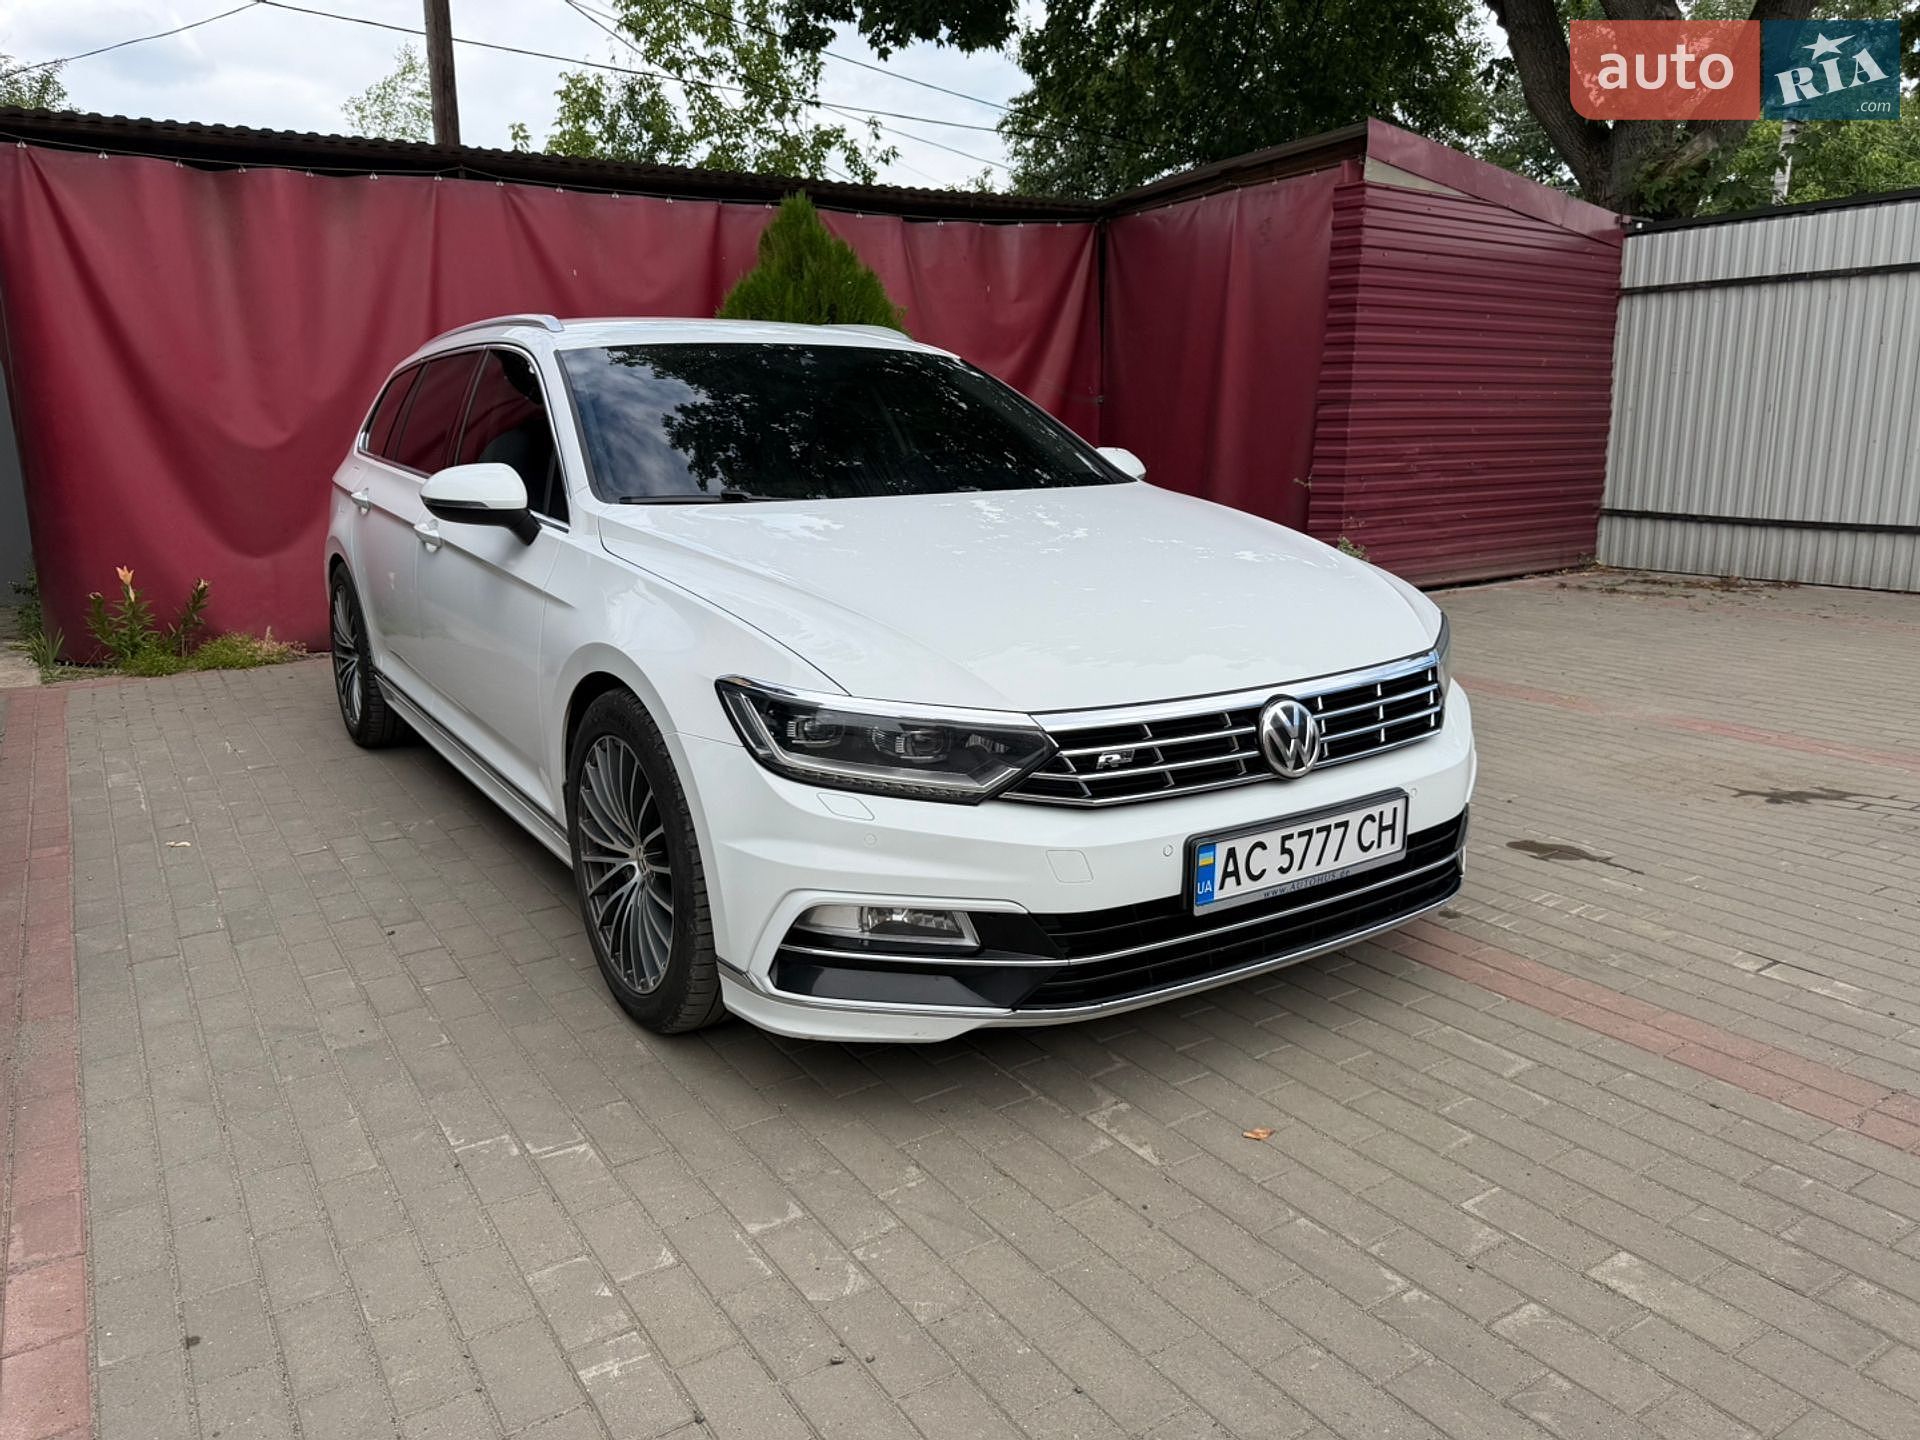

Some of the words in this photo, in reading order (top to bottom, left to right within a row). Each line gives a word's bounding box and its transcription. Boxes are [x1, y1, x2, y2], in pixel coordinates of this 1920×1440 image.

[1218, 840, 1268, 891] AC
[1277, 820, 1350, 875] 5777
[1357, 806, 1398, 853] CH
[1197, 880, 1212, 894] UA
